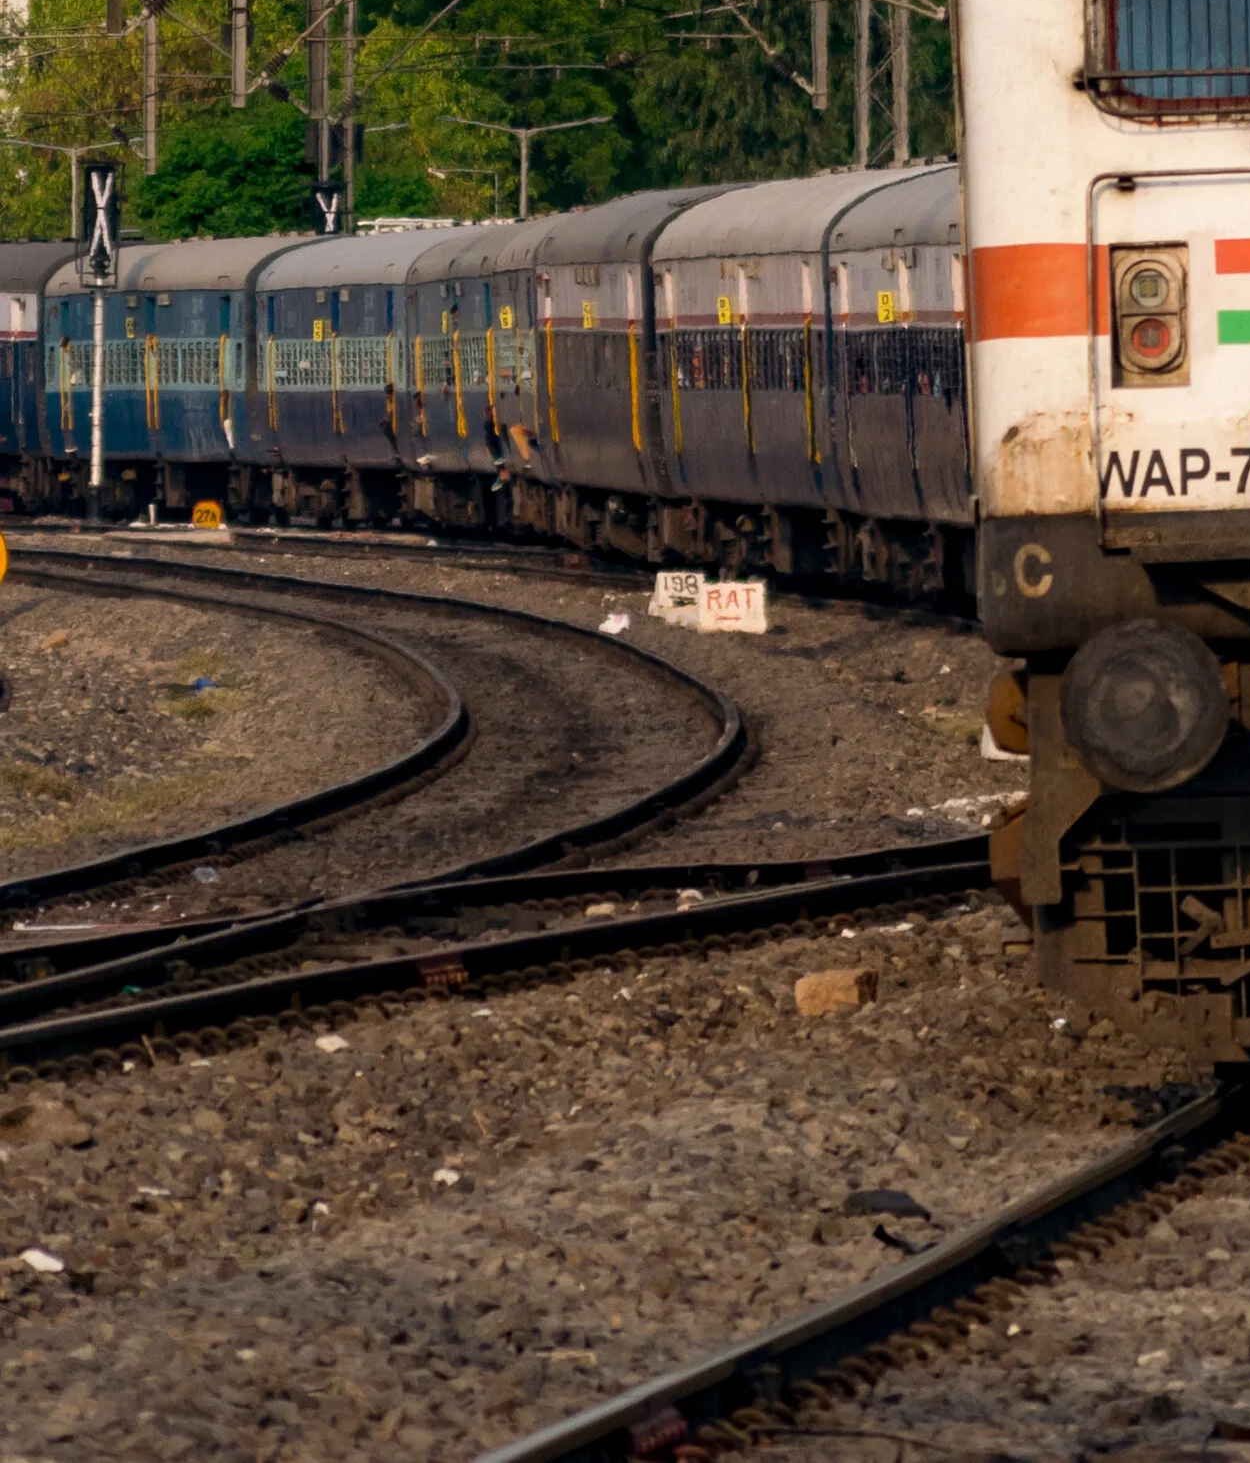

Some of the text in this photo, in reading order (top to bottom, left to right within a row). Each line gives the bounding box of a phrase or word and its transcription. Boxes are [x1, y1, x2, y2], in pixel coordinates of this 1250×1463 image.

[1014, 543, 1053, 598] C
[663, 574, 699, 595] 198
[706, 587, 756, 610] RAT
